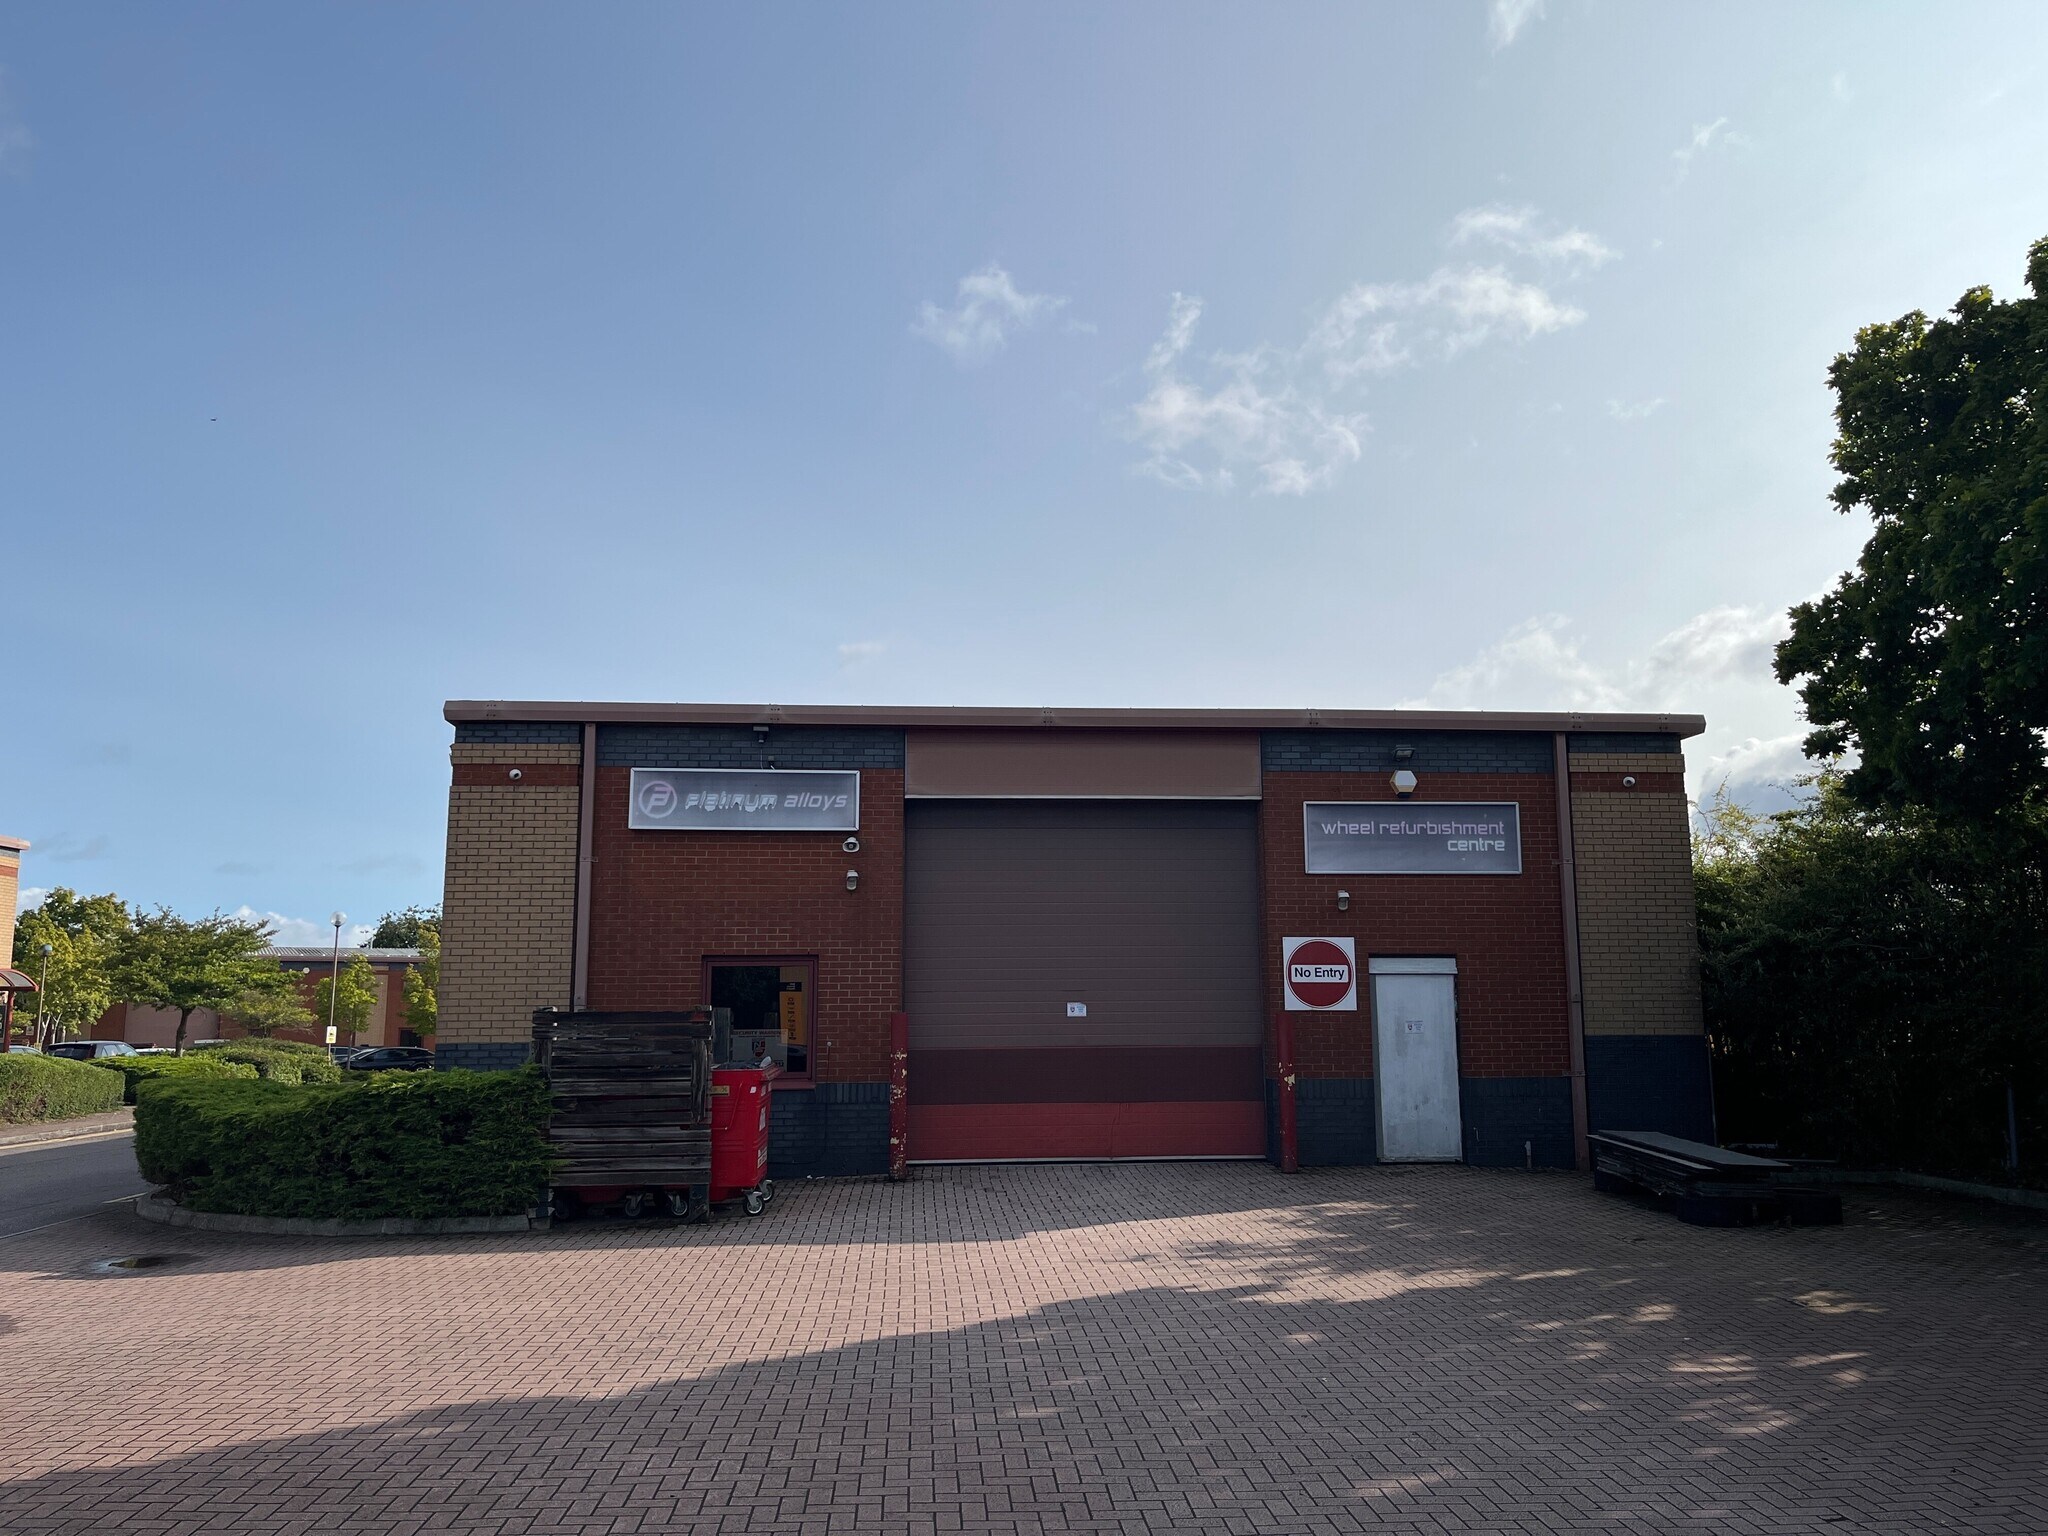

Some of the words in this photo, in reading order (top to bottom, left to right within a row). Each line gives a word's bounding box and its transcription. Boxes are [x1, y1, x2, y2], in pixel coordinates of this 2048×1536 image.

[784, 792, 848, 811] alloys
[1321, 820, 1375, 835] wheel
[1379, 821, 1505, 835] refurbishment
[1447, 838, 1505, 851] centre
[1294, 967, 1311, 978] No
[1314, 967, 1345, 980] Entry
